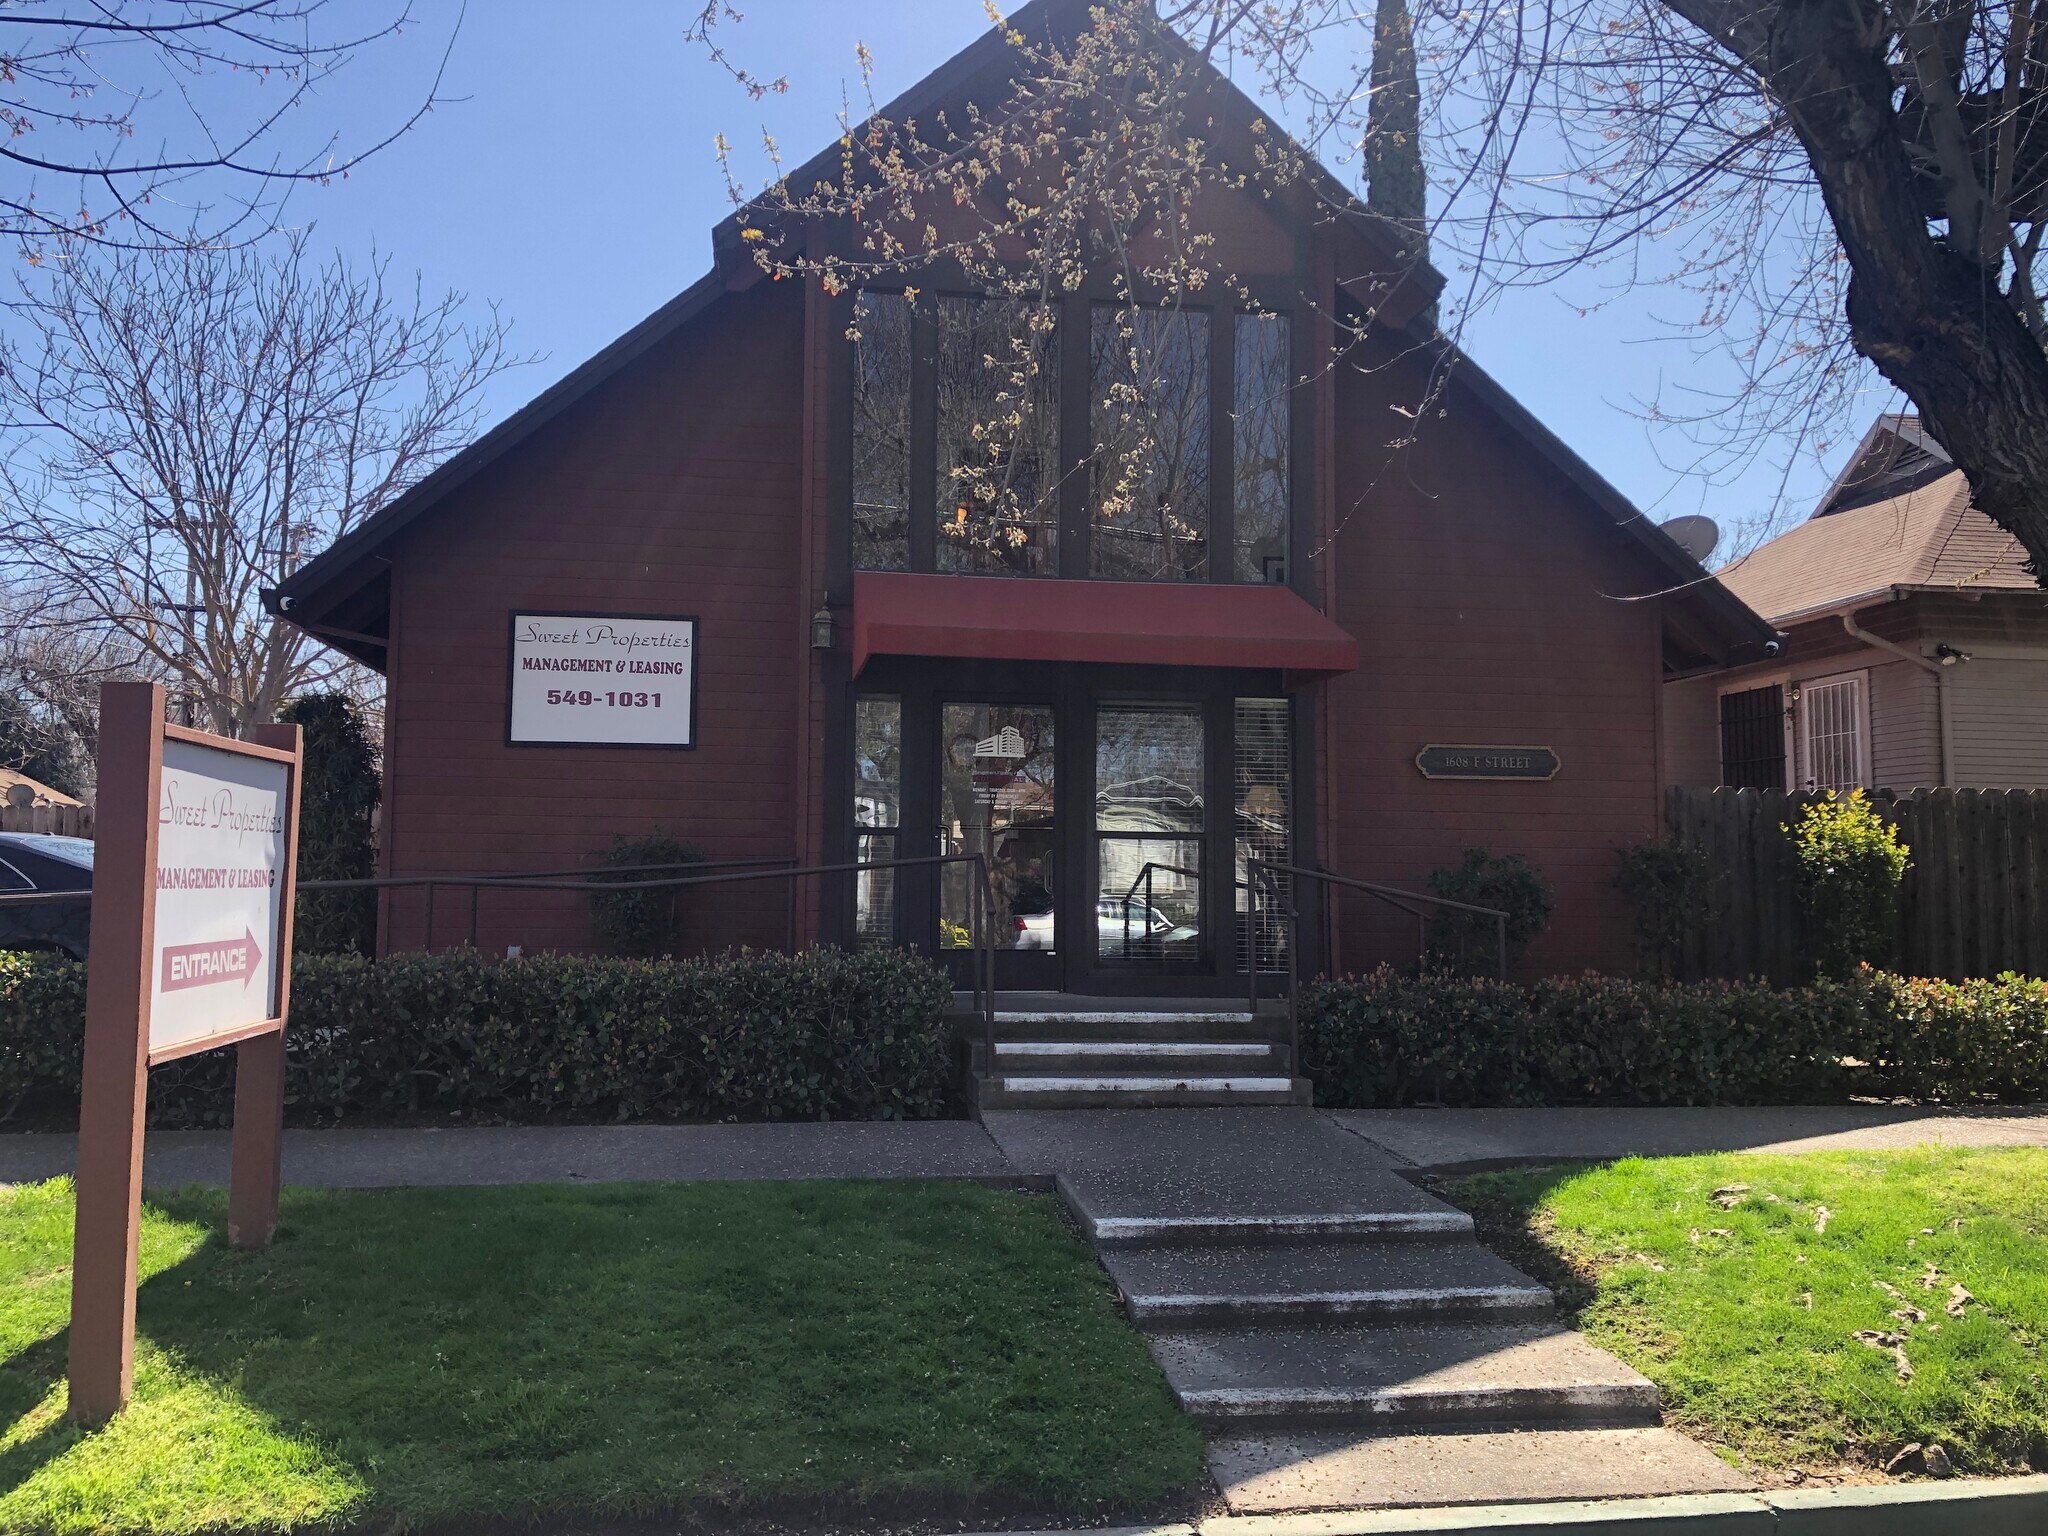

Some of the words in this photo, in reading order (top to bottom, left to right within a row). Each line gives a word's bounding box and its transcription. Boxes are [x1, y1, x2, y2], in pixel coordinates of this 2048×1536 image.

[515, 622, 579, 644] Sweet
[585, 624, 690, 654] Properties
[522, 657, 613, 673] MANAGEMENT
[615, 660, 626, 673] &
[629, 660, 683, 675] LEASING
[547, 689, 662, 708] 549-1031
[1445, 756, 1469, 769] 1608
[1485, 757, 1532, 769] STREET
[158, 780, 208, 829] Sweet
[211, 788, 283, 848] Properties
[156, 867, 227, 890] MANAGEMENT
[228, 868, 236, 888] &
[237, 868, 275, 888] LEASING
[170, 947, 247, 981] ENTRANCE
